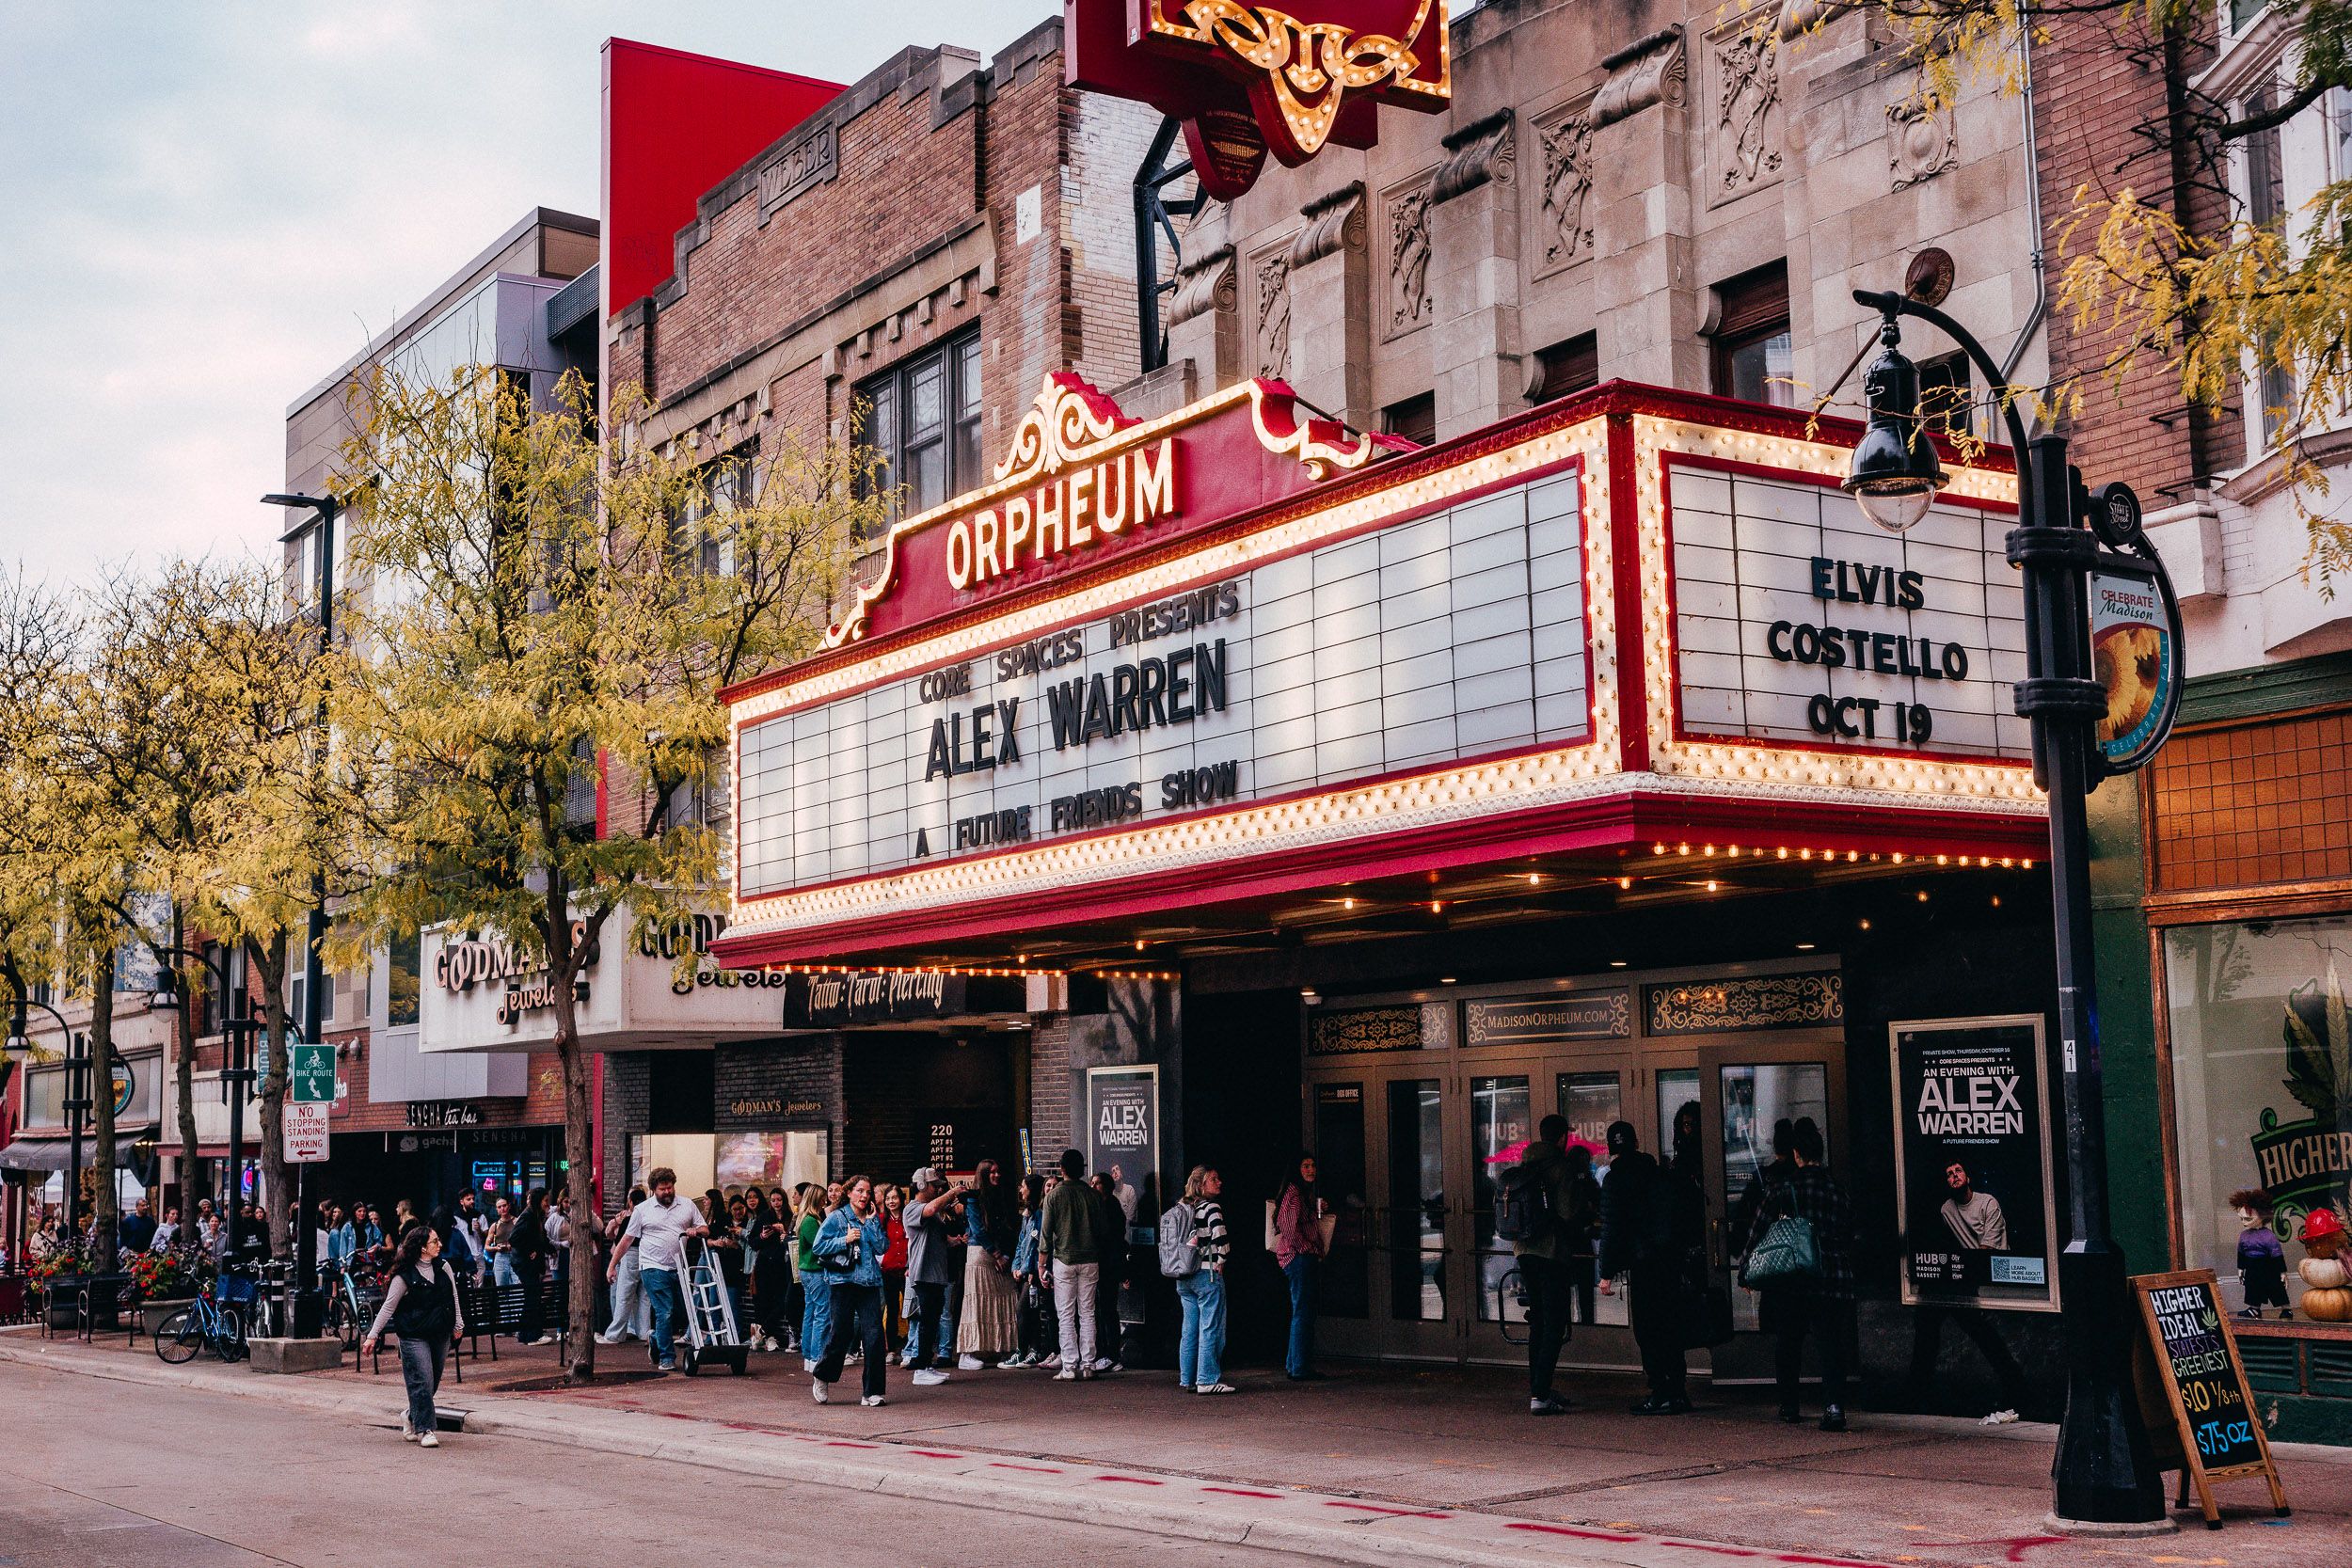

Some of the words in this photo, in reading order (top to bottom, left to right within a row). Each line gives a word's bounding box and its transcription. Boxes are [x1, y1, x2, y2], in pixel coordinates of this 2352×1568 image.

[761, 130, 831, 203] WEBER
[946, 436, 1176, 591] ORPHEUM
[2108, 500, 2130, 516] STATE
[1811, 556, 1925, 610] ELVIS
[2099, 599, 2153, 622] Madison
[2101, 589, 2153, 609] CELEBRATE
[919, 662, 971, 705] CORE
[997, 628, 1083, 682] SPACES
[1109, 579, 1238, 650] PRESENTS
[1767, 620, 1969, 681] COSTELLO
[925, 697, 1021, 783] ALEX
[1047, 638, 1226, 752] WARREN
[1807, 693, 1881, 739] OCT
[1896, 702, 1932, 744] 19
[2111, 691, 2164, 753] CELEBRATE
[915, 828, 930, 859] A
[956, 805, 1031, 850] FUTURE
[1051, 782, 1141, 833] FRIENDS
[1161, 760, 1238, 809] SHOW
[2066, 1041, 2074, 1054] 4
[1923, 1069, 1938, 1077] AN
[1940, 1067, 1984, 1076] EVENING
[1987, 1066, 2014, 1075] WITH
[1917, 1076, 2023, 1112] ALEX
[287, 1118, 326, 1128] STOPPING
[298, 1107, 313, 1117] NO
[406, 1103, 440, 1127] SENCHA
[444, 1104, 460, 1126] tea
[1099, 1105, 1147, 1129] ALEX
[1917, 1112, 2023, 1134] WARREN
[287, 1127, 326, 1136] STANDING
[472, 1131, 528, 1143] SENCHA
[931, 1125, 953, 1136] 220
[1099, 1130, 1148, 1146] WARREN
[290, 1139, 323, 1148] PARKING
[2260, 1132, 2352, 1189] HIGHER
[1915, 1253, 1939, 1265] HUB
[2150, 1286, 2205, 1315] HIGHER
[2158, 1312, 2205, 1340] IDEAL
[2171, 1349, 2229, 1378] GREENEST
[2181, 1381, 2211, 1413] $10
